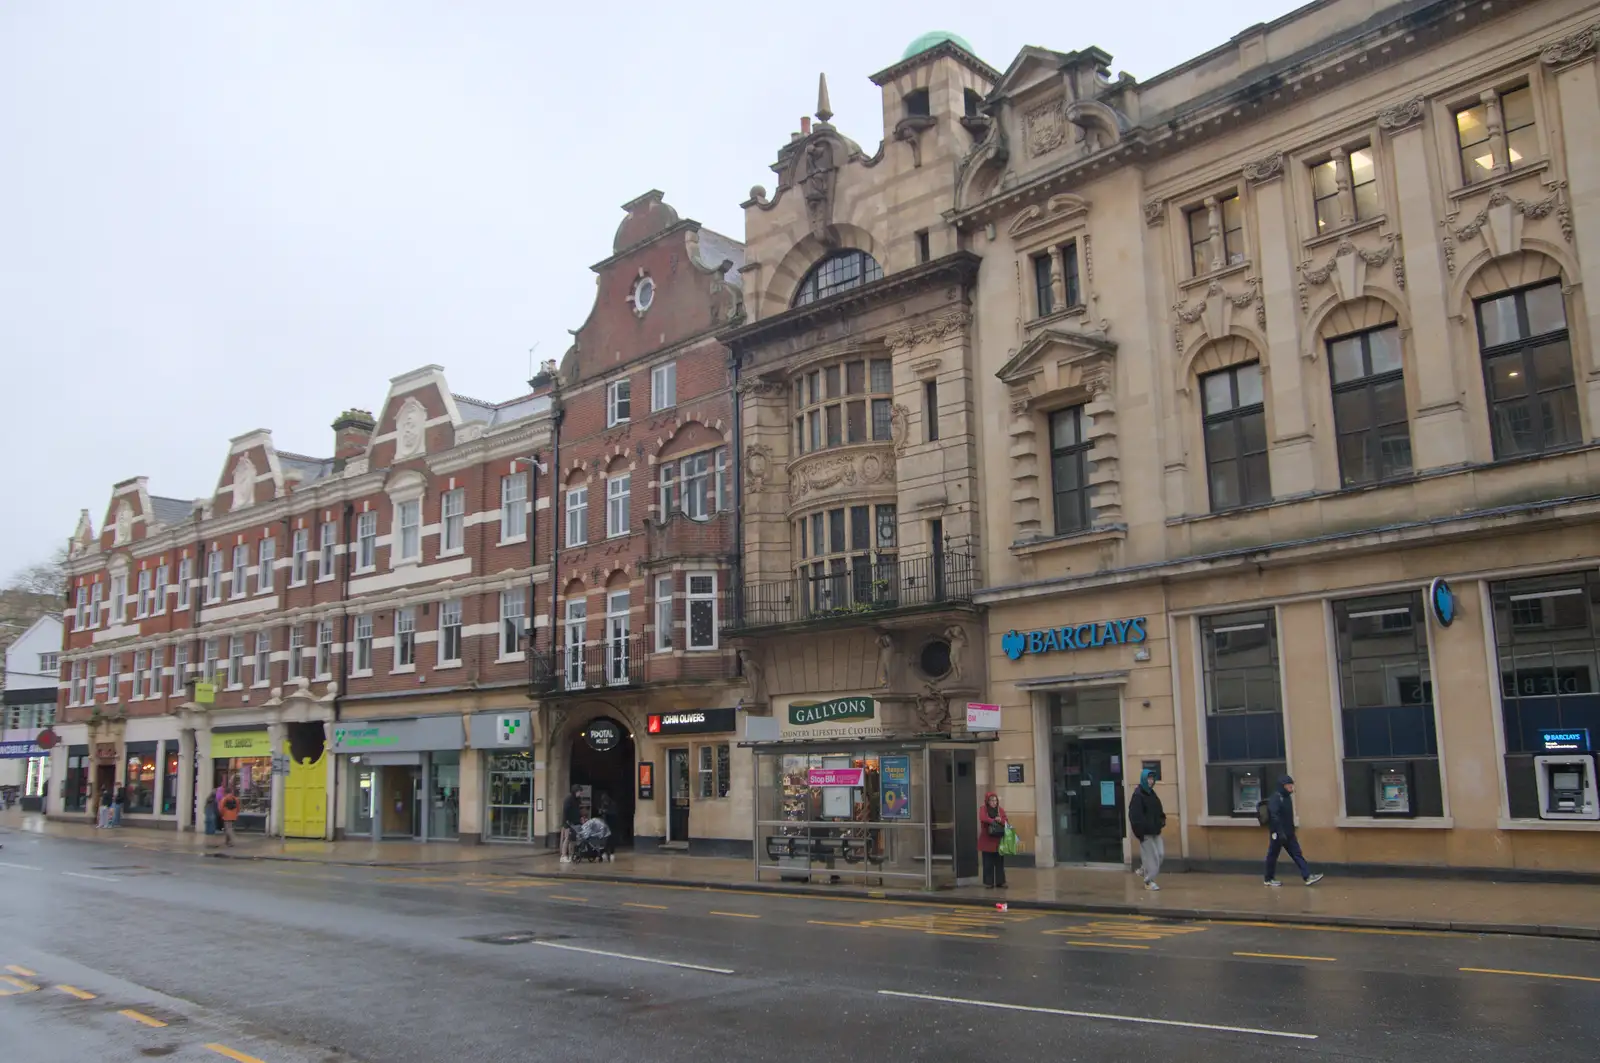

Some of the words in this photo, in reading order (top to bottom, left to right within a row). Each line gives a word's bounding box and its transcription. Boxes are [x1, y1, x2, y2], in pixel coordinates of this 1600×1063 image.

[1029, 617, 1147, 653] BARCLAYS
[796, 700, 866, 722] GALLYONS
[662, 715, 679, 724] JOHN
[680, 713, 705, 724] OLIVERS
[847, 725, 883, 735] CLOTHIN
[1550, 733, 1581, 741] BARCLAYS
[810, 774, 825, 784] Stop
[825, 775, 835, 783] BM
